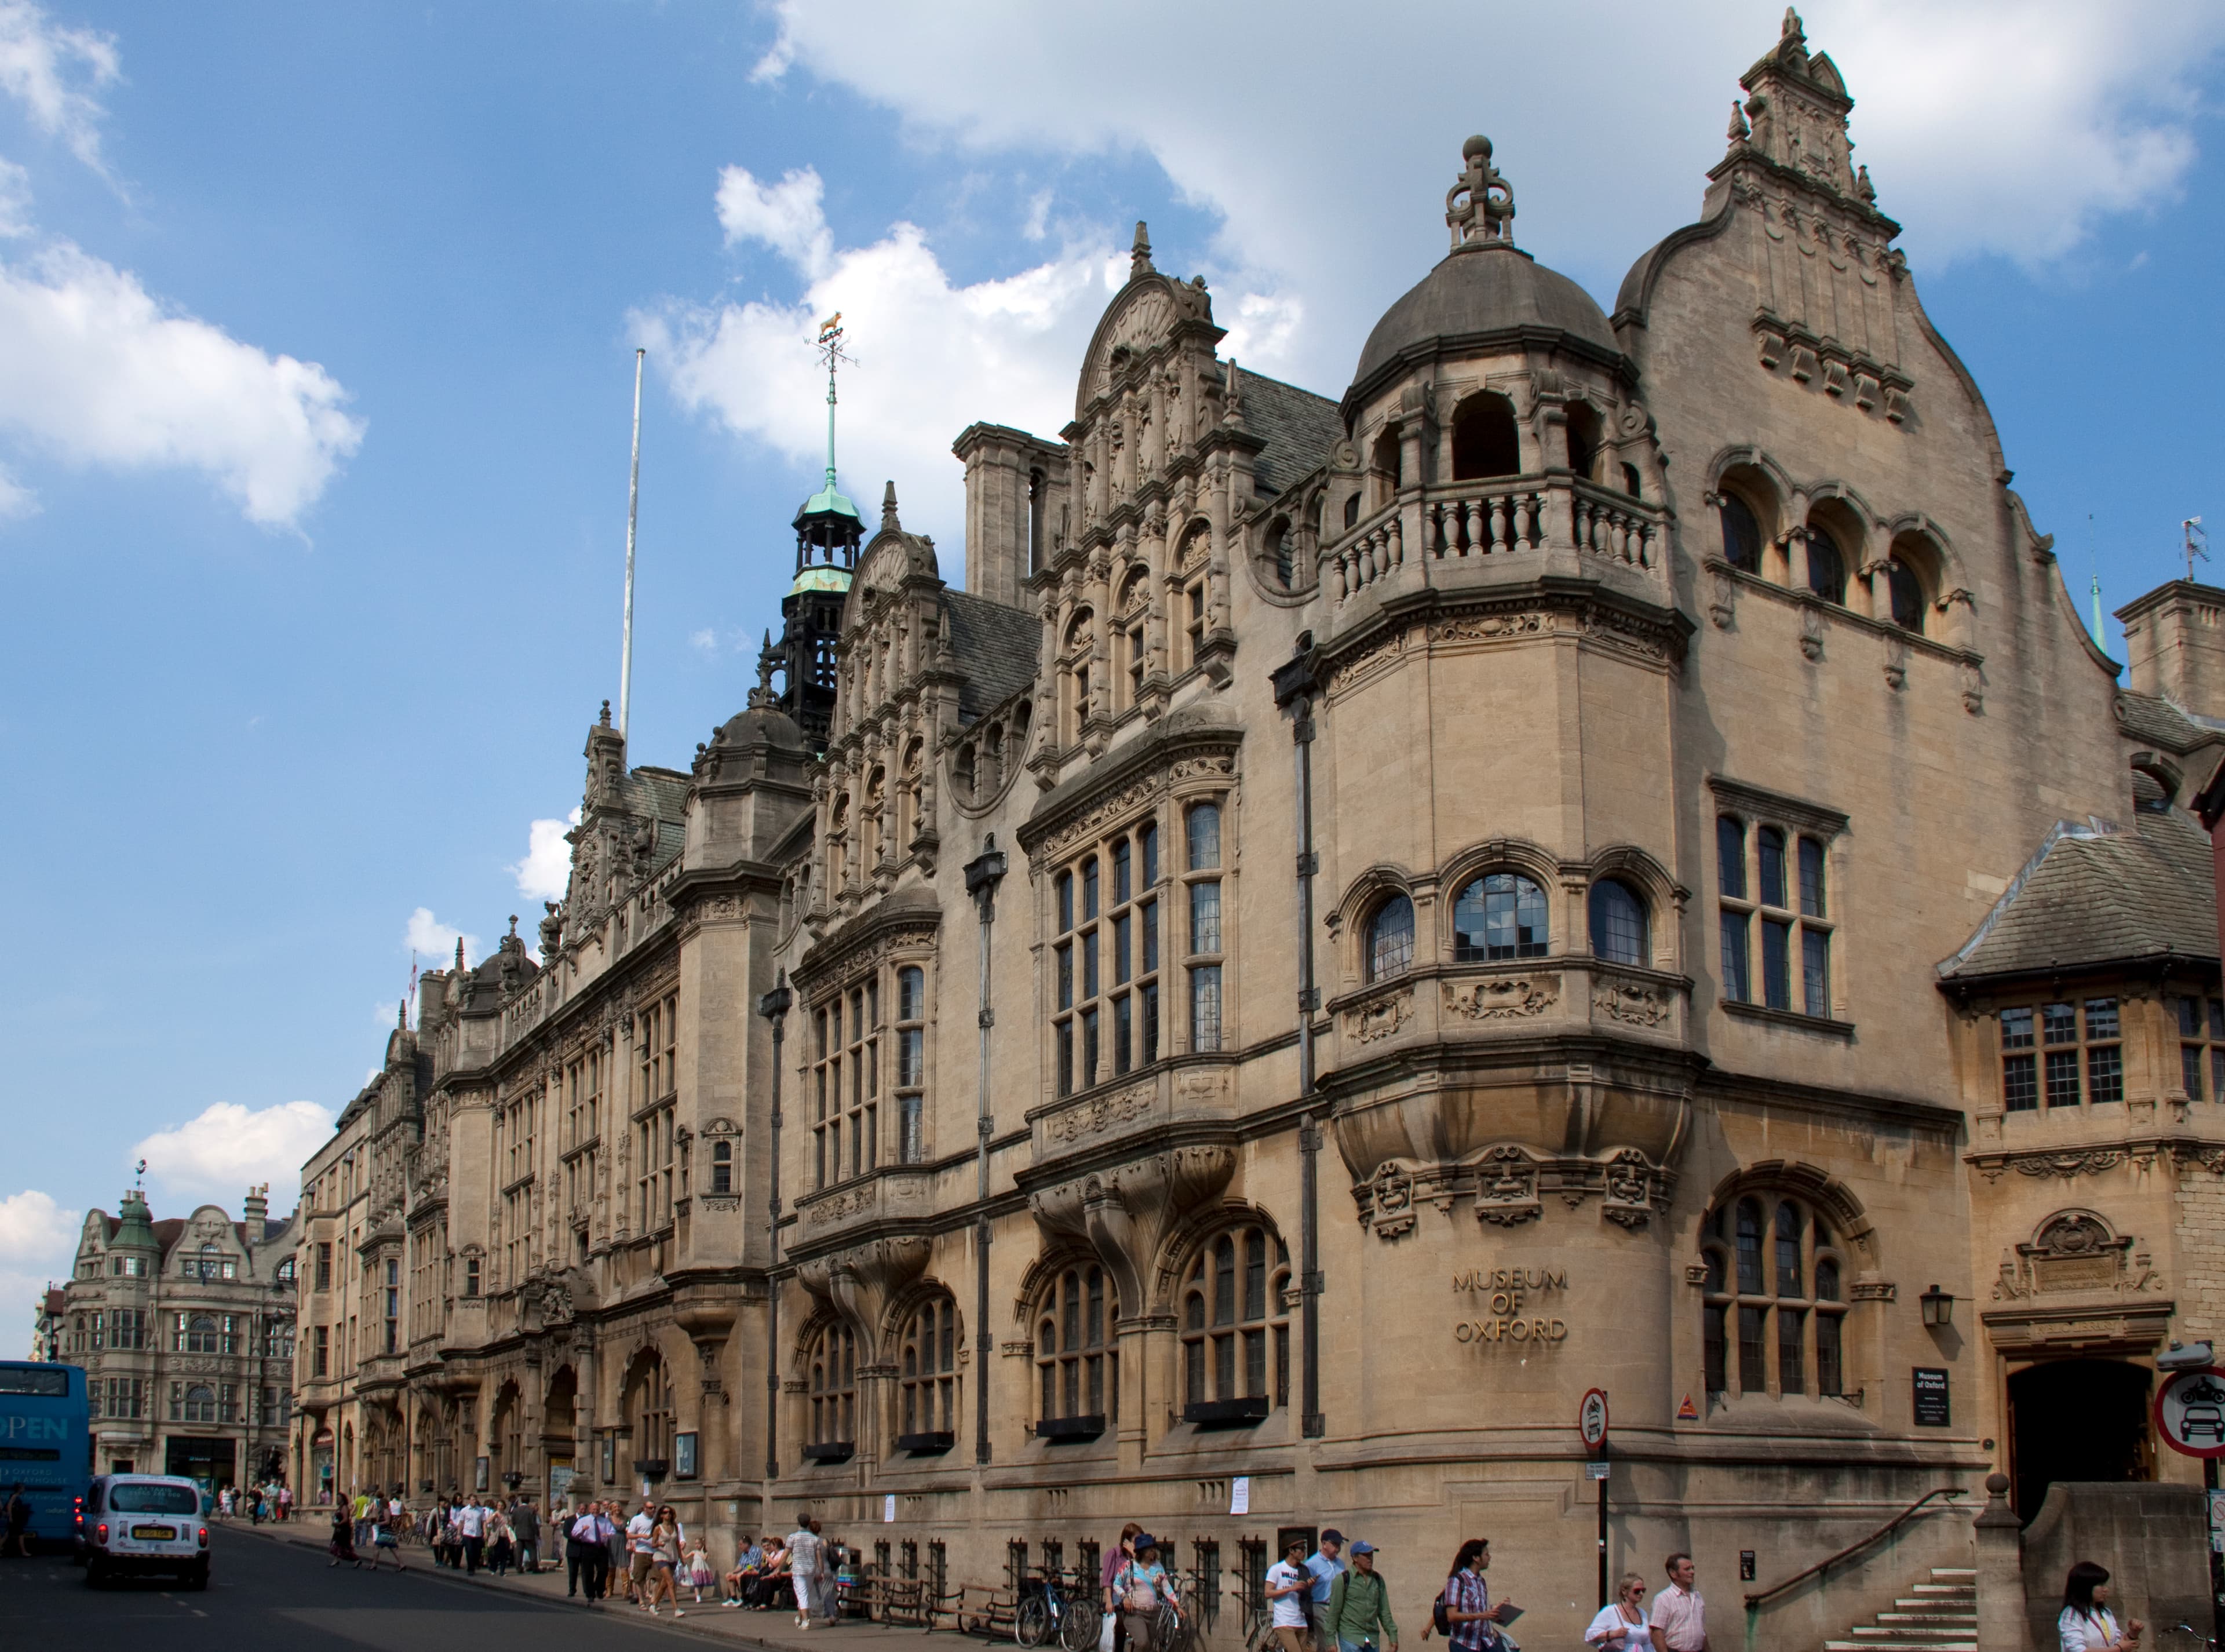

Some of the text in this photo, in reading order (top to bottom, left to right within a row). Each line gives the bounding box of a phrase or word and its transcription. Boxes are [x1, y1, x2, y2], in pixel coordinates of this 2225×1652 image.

[1452, 1267, 1568, 1292] MUSEUM
[1491, 1293, 1524, 1316] OF
[1456, 1318, 1568, 1343] OXFORD
[1918, 1372, 1943, 1380] Museum
[1924, 1381, 1946, 1390] Oxford
